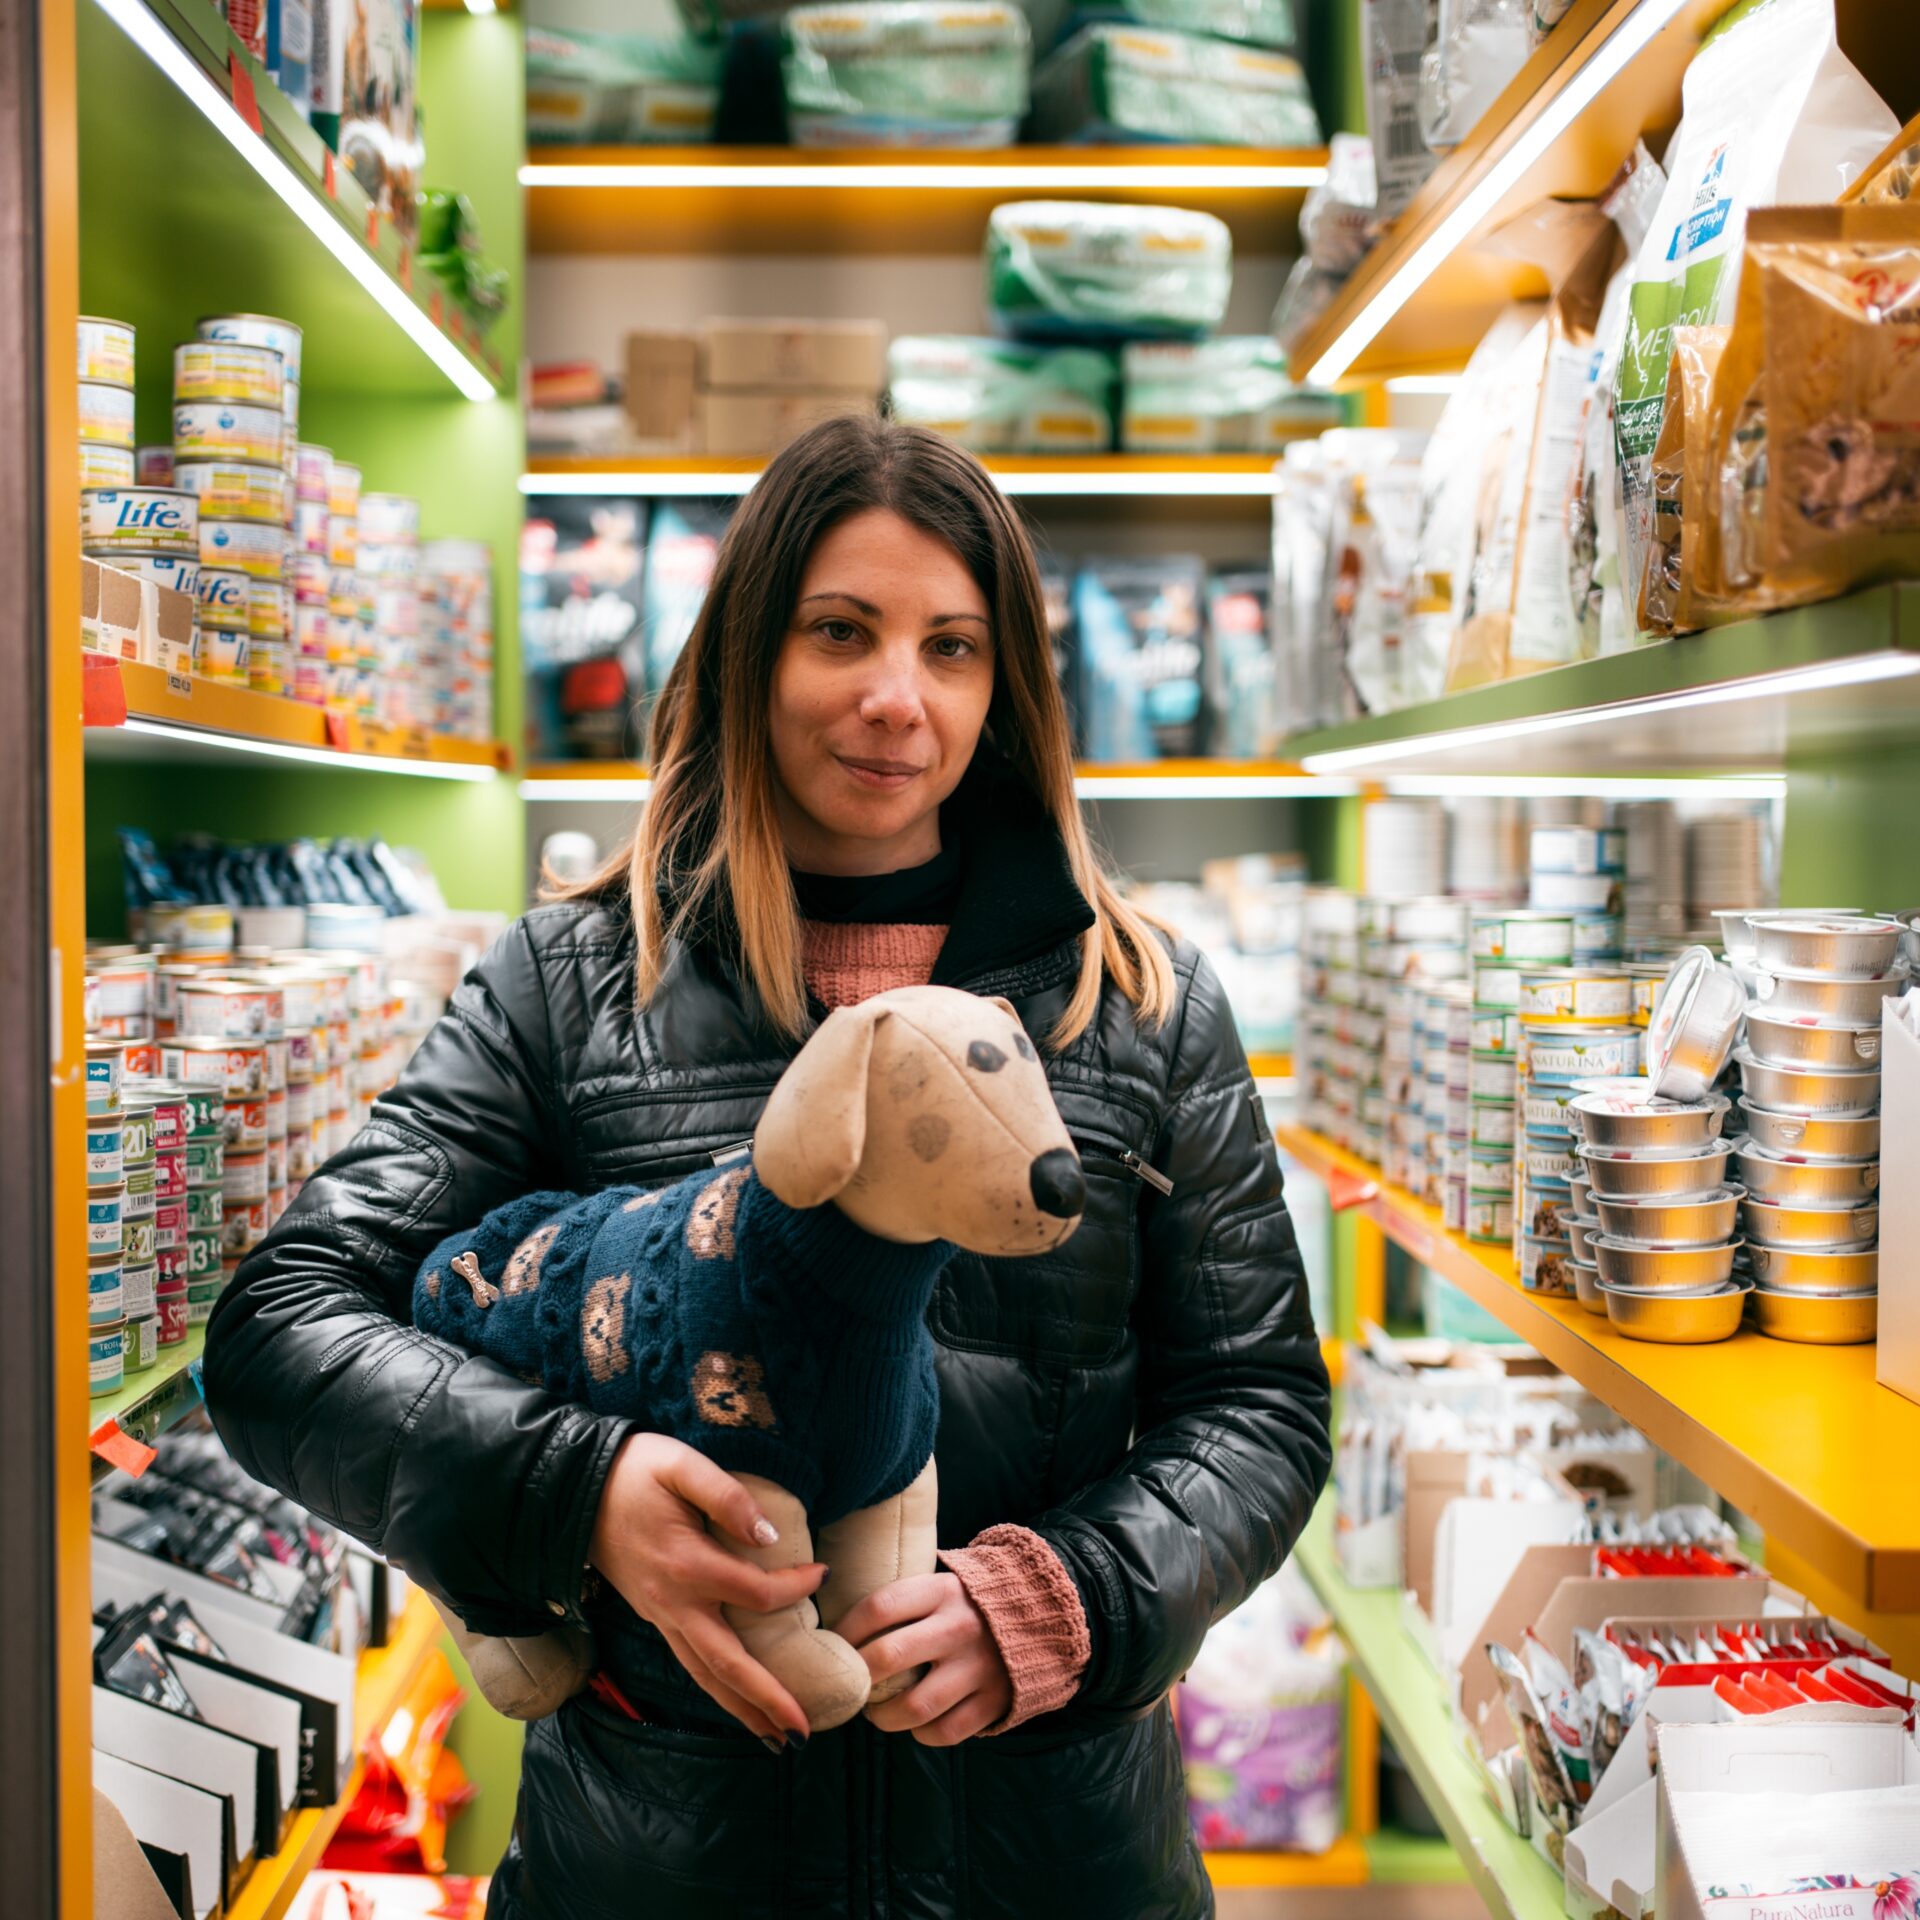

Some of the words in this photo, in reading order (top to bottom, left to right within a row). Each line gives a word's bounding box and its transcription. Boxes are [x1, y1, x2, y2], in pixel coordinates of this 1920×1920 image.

[116, 499, 181, 528] Life
[1533, 1054, 1605, 1069] NATURINA
[1750, 1903, 1855, 1920] PuraNatura
